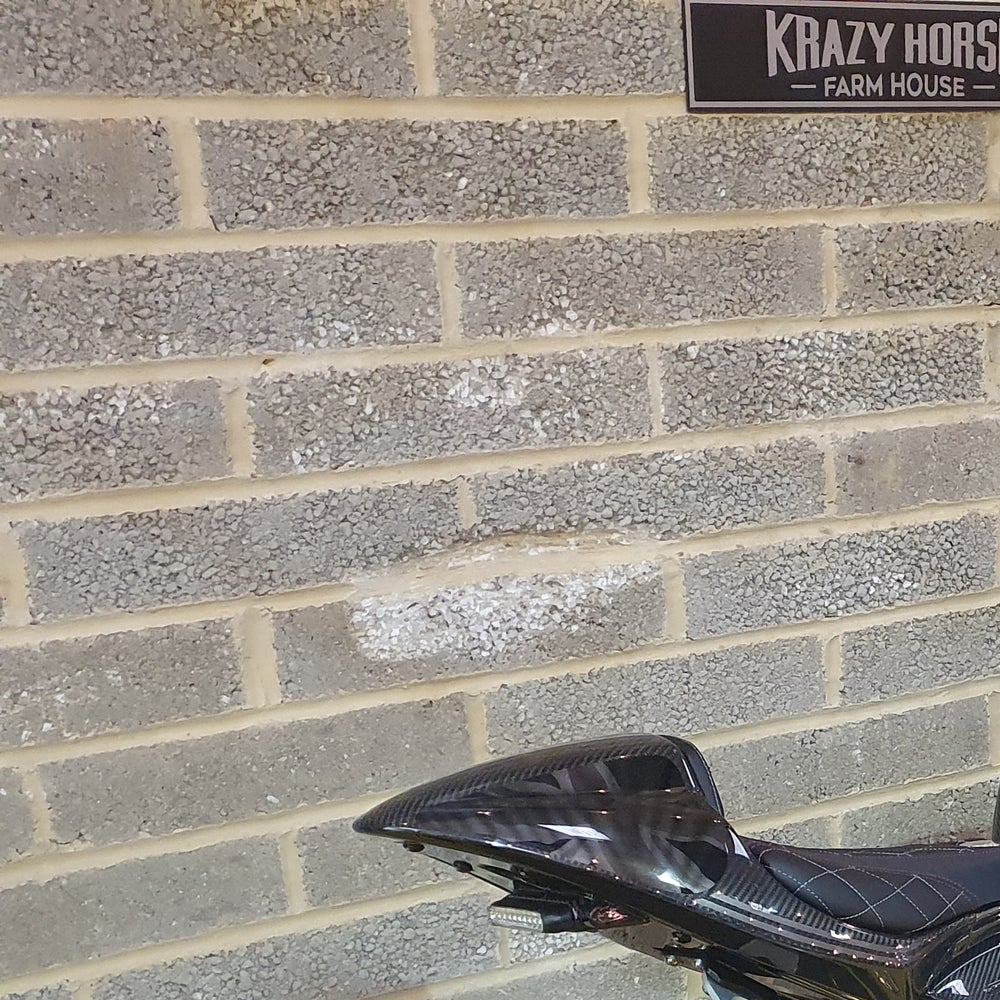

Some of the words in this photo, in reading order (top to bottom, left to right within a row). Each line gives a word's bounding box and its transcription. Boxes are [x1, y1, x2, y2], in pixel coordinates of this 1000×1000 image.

[765, 9, 894, 78] KRAZY
[824, 74, 884, 97] FARM
[890, 72, 965, 97] HOUSE
